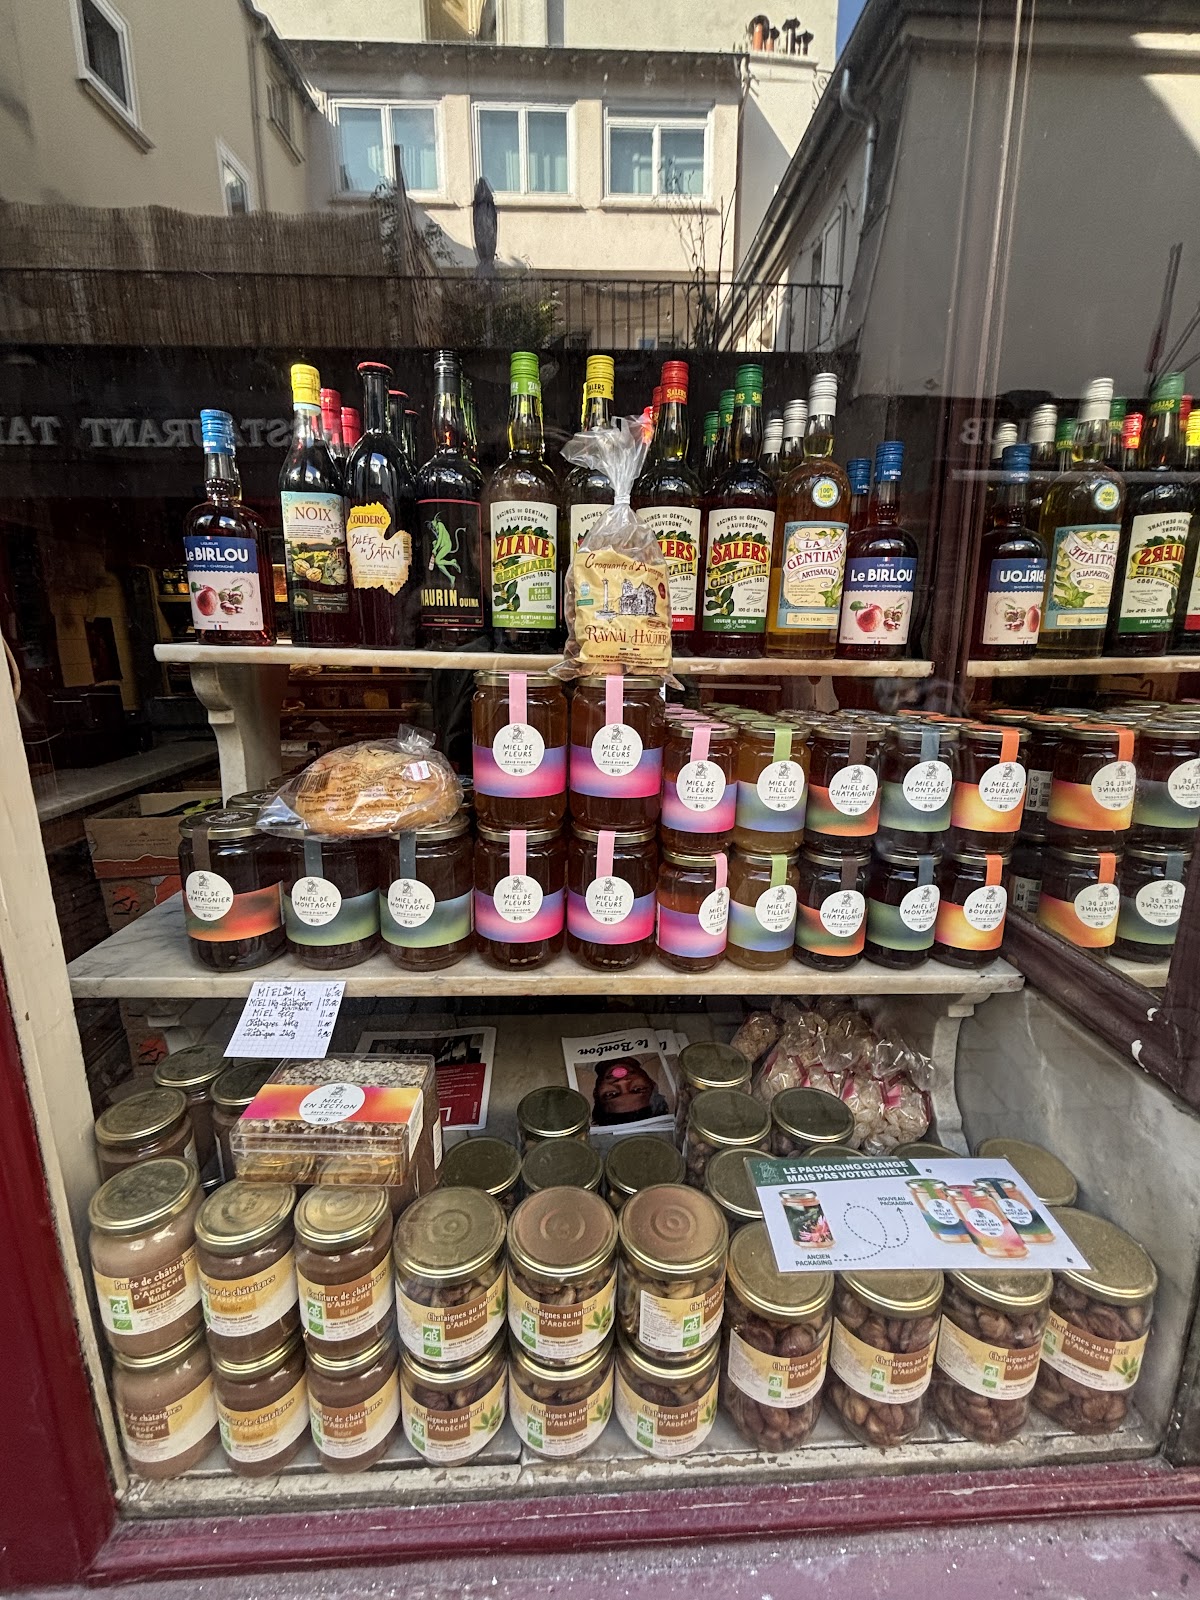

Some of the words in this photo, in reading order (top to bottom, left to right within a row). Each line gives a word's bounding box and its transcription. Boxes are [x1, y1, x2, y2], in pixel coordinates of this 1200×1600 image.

[294, 506, 332, 521] NOIX
[350, 514, 386, 525] COUDERC
[496, 507, 515, 520] RACINES
[524, 507, 549, 522] GENTIANE
[669, 513, 693, 526] GENTIANE
[716, 514, 738, 528] RACINES
[746, 514, 768, 529] GENTIANE
[496, 535, 550, 559] ZIANE
[659, 540, 693, 561] LERS
[805, 540, 820, 549] LA
[185, 548, 194, 561] Le
[195, 548, 249, 563] BIRLOU
[712, 541, 768, 566] SALERS
[787, 543, 844, 570] GENTIANE
[496, 558, 553, 582] GENTIANE
[584, 553, 628, 575] Croquants
[710, 563, 767, 589] GENTIANE
[801, 568, 837, 580] ARTISANALE
[851, 569, 865, 582] Le
[867, 569, 913, 583] BIRLOU
[585, 624, 629, 644] RAYNAL
[503, 750, 532, 758] FLEURS
[685, 779, 704, 787] MIEL
[768, 779, 786, 787] MIEL
[789, 779, 797, 787] DE
[831, 789, 875, 797] CHATAIGNIER
[187, 895, 231, 903] CHATAIGNIER
[394, 896, 410, 904] MIEL
[595, 894, 613, 902] MIEL
[390, 901, 431, 911] MONTAGNE
[708, 907, 722, 915] MIEL
[785, 901, 792, 909] DE
[822, 912, 863, 921] CHATAIGNIER
[248, 998, 267, 1007] MIEL
[252, 1007, 273, 1017] MIEL
[578, 1038, 635, 1056] Bonbon
[635, 1038, 648, 1049] le
[783, 1167, 797, 1175] LE
[799, 1163, 862, 1174] PACKAGING
[863, 1161, 909, 1170] CHANGE
[787, 1174, 817, 1183] MAIS
[817, 1172, 840, 1181] PAS
[840, 1170, 877, 1179] VOTRE
[876, 1168, 905, 1177] MIEL
[115, 1278, 139, 1290] Purée
[141, 1276, 152, 1286] de
[134, 1274, 184, 1301] D'ARDÈCHE
[220, 1289, 230, 1297] de
[232, 1275, 276, 1297] châtaignes
[148, 1290, 171, 1304] Nature
[340, 1291, 351, 1301] de
[468, 1305, 478, 1315] au
[573, 1301, 597, 1318] naturel
[445, 1311, 486, 1330] D'ARDÈCHE
[540, 1318, 581, 1328] D'ARDÈCHE
[1090, 1342, 1103, 1352] au
[139, 1404, 183, 1421] châtaignes
[243, 1418, 254, 1426] de
[255, 1398, 295, 1425] châtaignes
[335, 1413, 344, 1422] de
[568, 1410, 577, 1418] au
[323, 1419, 364, 1430] D'ARDÈCHE
[428, 1422, 468, 1432] D'ARDÈCHE
[546, 1416, 586, 1427] D'ARDÈCHE
